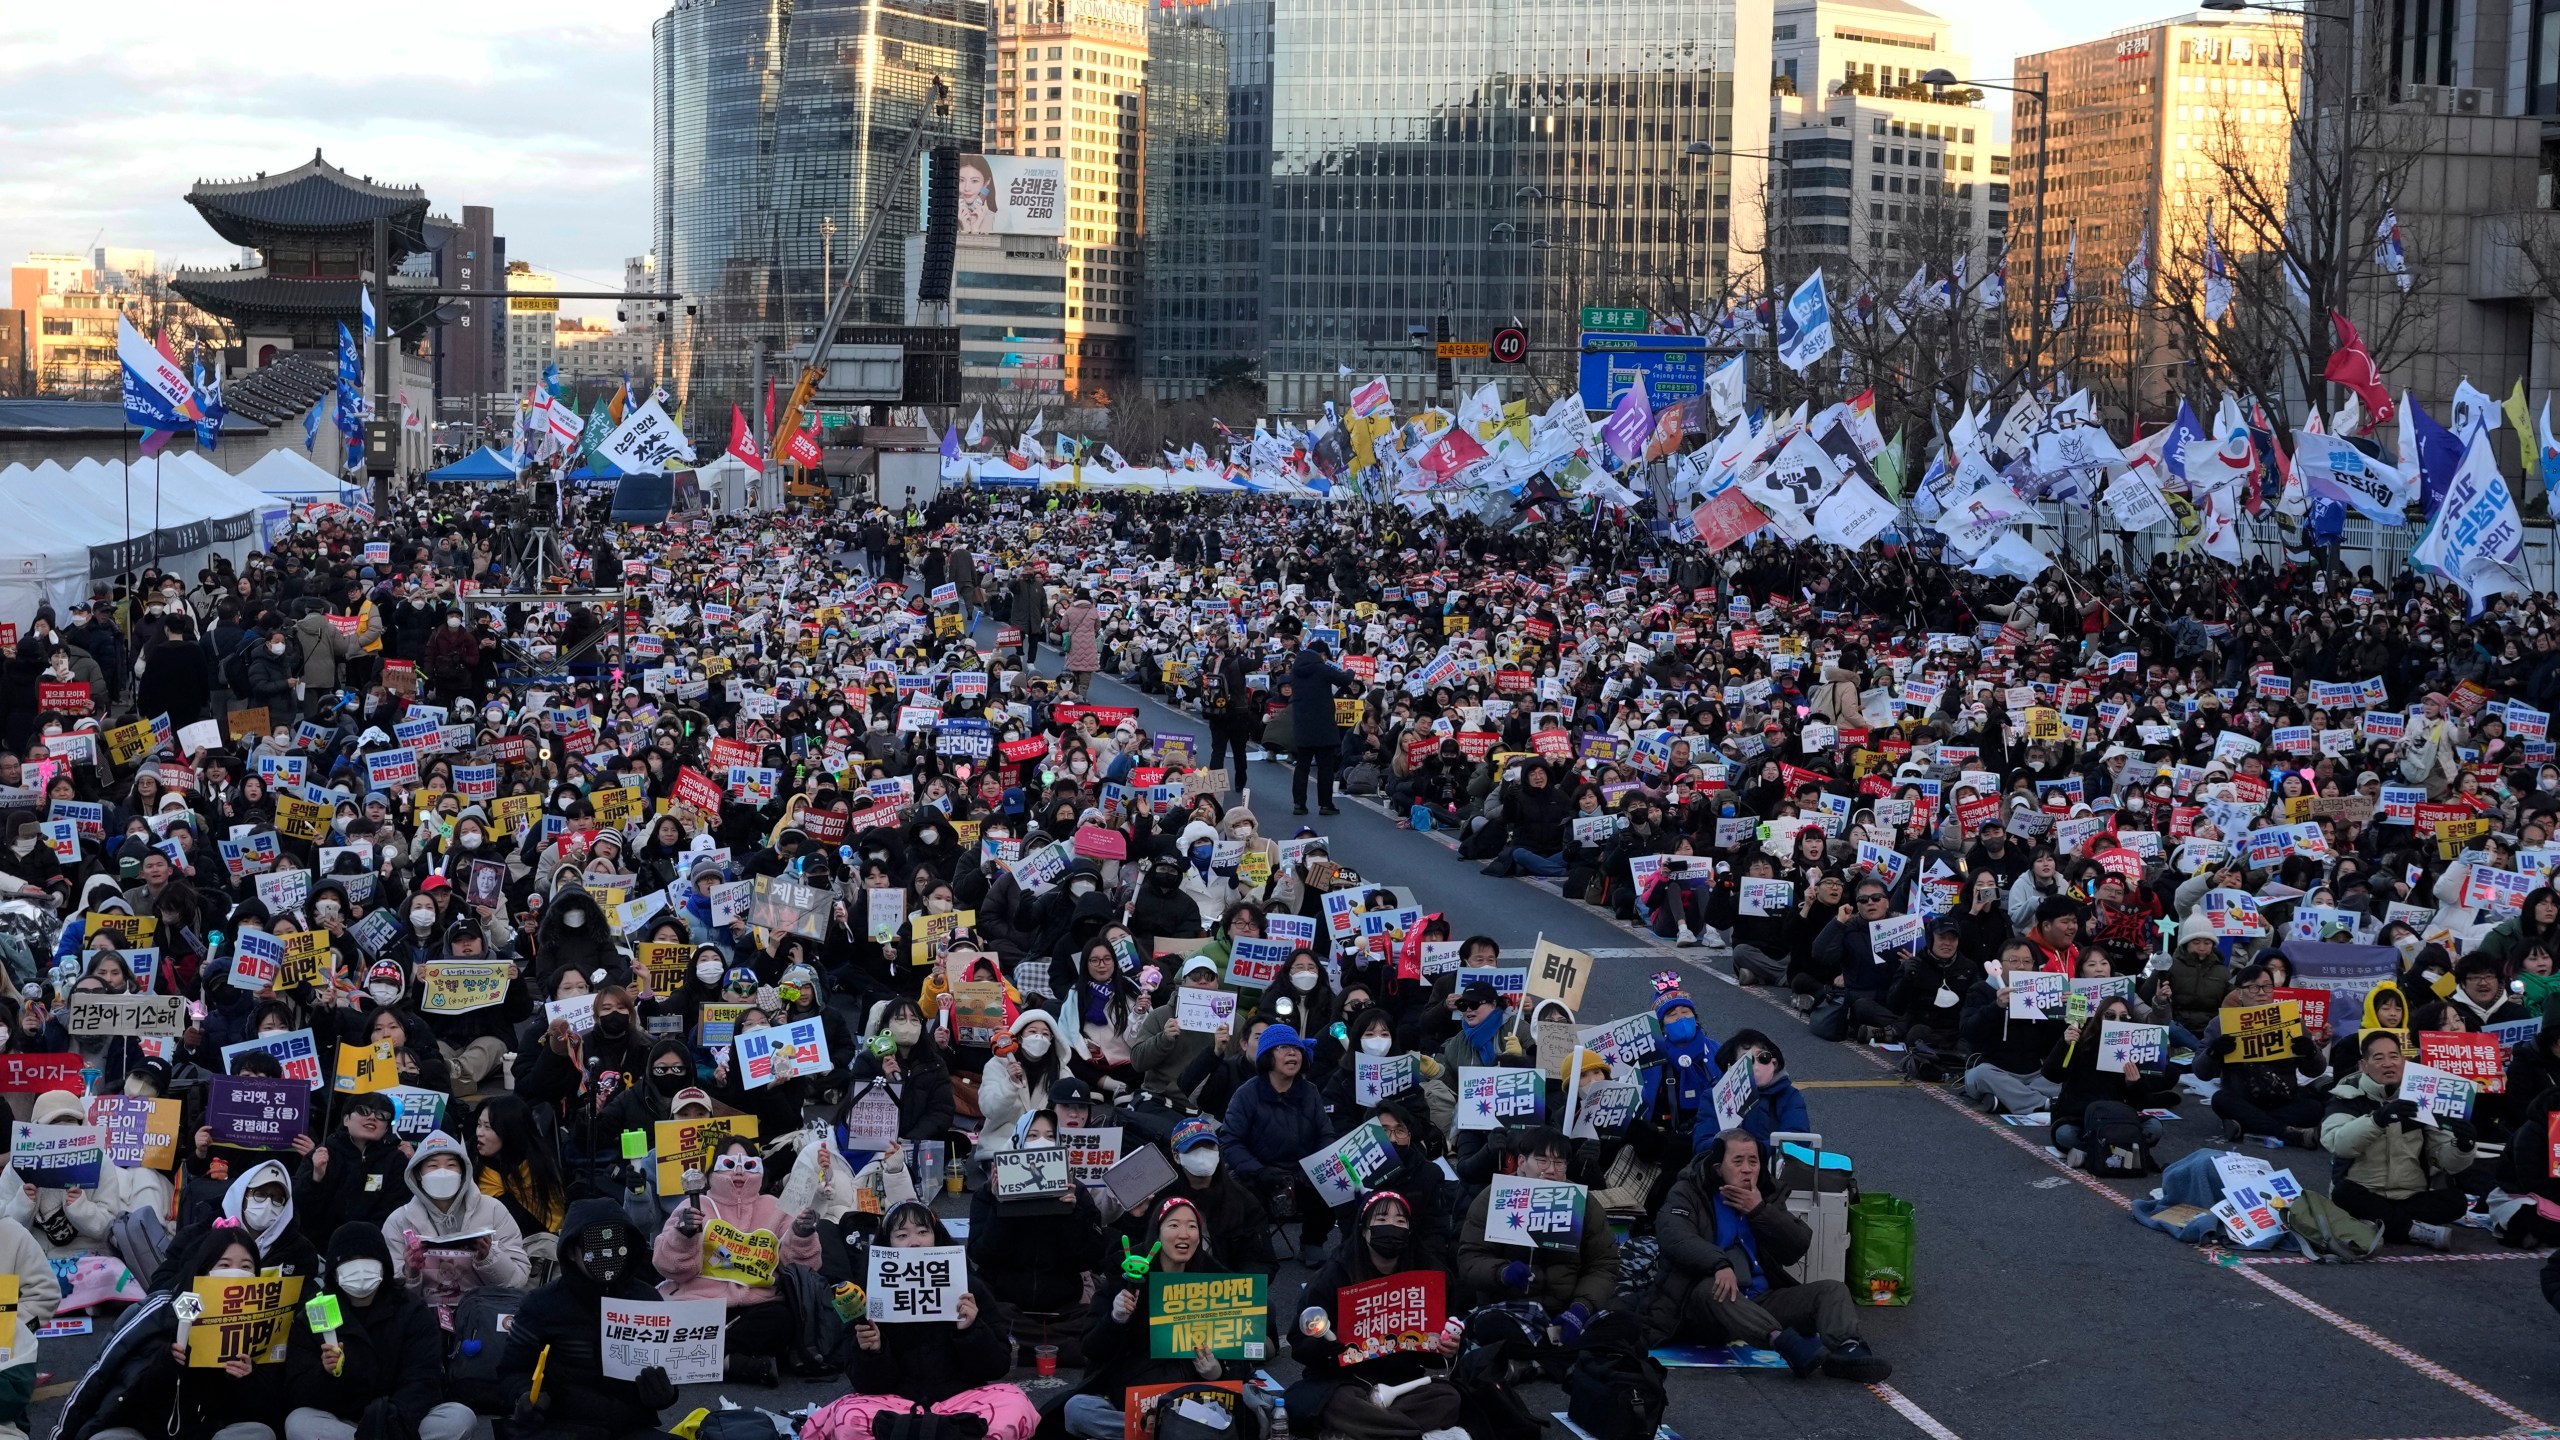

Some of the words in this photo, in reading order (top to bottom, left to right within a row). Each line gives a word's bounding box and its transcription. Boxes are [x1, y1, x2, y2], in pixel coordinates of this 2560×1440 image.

[2117, 36, 2149, 54] 아주경제
[1010, 178, 1058, 195] 상쾌환
[1009, 196, 1054, 207] BOOSTER
[1027, 207, 1052, 218] ZERO
[1590, 311, 1635, 325] 광화문
[1439, 344, 1487, 357] 과속단속장비
[1500, 338, 1518, 354] 40
[1653, 363, 1697, 372] 세종대로
[157, 364, 189, 396] HEALTH
[1652, 372, 1697, 381] Sejong-daero
[167, 386, 184, 405] ALL
[795, 435, 818, 457] 진보당
[954, 675, 986, 684] 국민의힘
[2260, 677, 2290, 688] 국민의힘
[2319, 685, 2351, 696] 국민의힘
[2367, 714, 2402, 727] 국민의힘
[2509, 712, 2547, 725] 국민의힘
[114, 726, 139, 743] 윤석열
[397, 721, 437, 737] 국민의힘
[451, 725, 471, 738] 해체
[2036, 721, 2059, 738] 파면
[2274, 728, 2310, 741] 국민의힘
[65, 736, 86, 750] 해체
[453, 737, 471, 747] 하라
[936, 736, 993, 759] 퇴진하라
[67, 750, 88, 761] 하라
[120, 741, 145, 760] 파면
[369, 751, 414, 768] 국민의힘
[454, 768, 495, 781] 국민의힘
[501, 797, 527, 813] 윤석열
[602, 789, 628, 805] 윤석열
[53, 805, 100, 820] 국민의힘
[290, 802, 319, 816] 윤석열
[825, 817, 846, 828] OUT!
[2447, 822, 2477, 834] 윤석열
[824, 827, 844, 837] OUT!
[2136, 832, 2158, 845] 해체
[1033, 847, 1059, 871] 해체
[2139, 844, 2159, 858] 하라
[1041, 859, 1066, 882] 하라
[281, 872, 306, 888] 즉각
[2476, 868, 2531, 893] 윤석열
[771, 882, 813, 908] 제발
[1764, 883, 1789, 898] 즉각
[1763, 897, 1789, 910] 파면
[926, 914, 958, 935] 윤석열
[2336, 920, 2345, 930] C
[652, 947, 691, 965] 윤석열
[1236, 942, 1293, 962] 국민의힘
[281, 961, 317, 986] 파면
[1422, 965, 1441, 975] 즉각
[2012, 978, 2035, 988] 내란동조
[2012, 986, 2035, 995] 국민의힘
[2035, 975, 2063, 996] 해체
[2305, 1001, 2325, 1012] 복을
[72, 1003, 120, 1030] 검찰아
[125, 1003, 177, 1029] 기소해
[2239, 1006, 2281, 1029] 윤석열
[2305, 1014, 2325, 1028] 벌을
[1613, 1016, 1652, 1047] 해체
[2104, 1030, 2130, 1039] 내란동조
[2131, 1028, 2162, 1047] 해체
[2104, 1037, 2130, 1046] 국민의힘
[2242, 1029, 2285, 1060] 파면
[1619, 1036, 1656, 1064] 하라
[2130, 1046, 2160, 1064] 하라
[2427, 1044, 2471, 1060] 국민에게
[2473, 1045, 2496, 1061] 복을
[8, 1060, 78, 1086] 모이자
[1358, 1064, 1379, 1072] 내란수괴
[1380, 1056, 1413, 1079] 즉각
[2475, 1060, 2498, 1076] 벌을
[1359, 1071, 1379, 1081] 윤석열
[1464, 1077, 1495, 1088] 내란수괴
[1496, 1070, 1536, 1095] 즉각
[2407, 1075, 2437, 1085] 내란수괴
[1381, 1076, 1413, 1098] 파면
[1464, 1086, 1495, 1099] 윤석열
[2407, 1083, 2436, 1094] 윤석열
[2437, 1078, 2471, 1100] 즉각
[231, 1090, 270, 1106] 줄리엣,
[274, 1092, 286, 1105] 전
[1600, 1087, 1634, 1108] 해체
[97, 1099, 124, 1112] 내가
[128, 1100, 156, 1113] 그게
[262, 1106, 299, 1120] 을(를)
[1495, 1095, 1535, 1117] 파면
[2433, 1098, 2466, 1119] 파면
[96, 1115, 136, 1128] 용납이
[1593, 1107, 1627, 1128] 하라
[232, 1119, 280, 1134] 경멸해요
[815, 1121, 828, 1139] 사형
[853, 1126, 895, 1137] 해체하라
[16, 1140, 55, 1152] 내란수괴
[58, 1135, 96, 1149] 윤석열은
[111, 1132, 138, 1145] 되는
[142, 1134, 171, 1147] 애야
[13, 1155, 38, 1170] 즉각
[42, 1150, 97, 1169] 퇴진하라!
[997, 1154, 1020, 1167] NO
[1026, 1151, 1064, 1165] PAIN
[1087, 1150, 1115, 1166] 퇴진
[1000, 1183, 1022, 1193] YES
[1496, 1188, 1530, 1198] 내란수괴
[1531, 1186, 1577, 1206] 즉각
[1495, 1198, 1529, 1210] 윤석열
[1528, 1211, 1573, 1233] 파면
[712, 1224, 745, 1242] 외계인
[726, 1242, 752, 1256] 반대한
[753, 1249, 776, 1264] 사람이
[871, 1249, 881, 1258] 긴말
[881, 1250, 900, 1260] 안한다
[879, 1260, 951, 1288] 윤석열
[223, 1281, 283, 1314] 윤석열
[893, 1288, 942, 1316] 퇴진
[1163, 1278, 1253, 1314] 생명안전
[1354, 1286, 1426, 1318] 국민의힘
[606, 1312, 629, 1325] 역사
[633, 1314, 671, 1327] 쿠데타
[1353, 1308, 1428, 1339] 해체하라
[217, 1318, 275, 1363] 파면
[606, 1325, 669, 1343] 내란수괴
[672, 1325, 719, 1343] 윤석열
[1172, 1319, 1243, 1353] 사회로!
[609, 1344, 659, 1368] 체포!
[665, 1344, 717, 1369] 구속!
